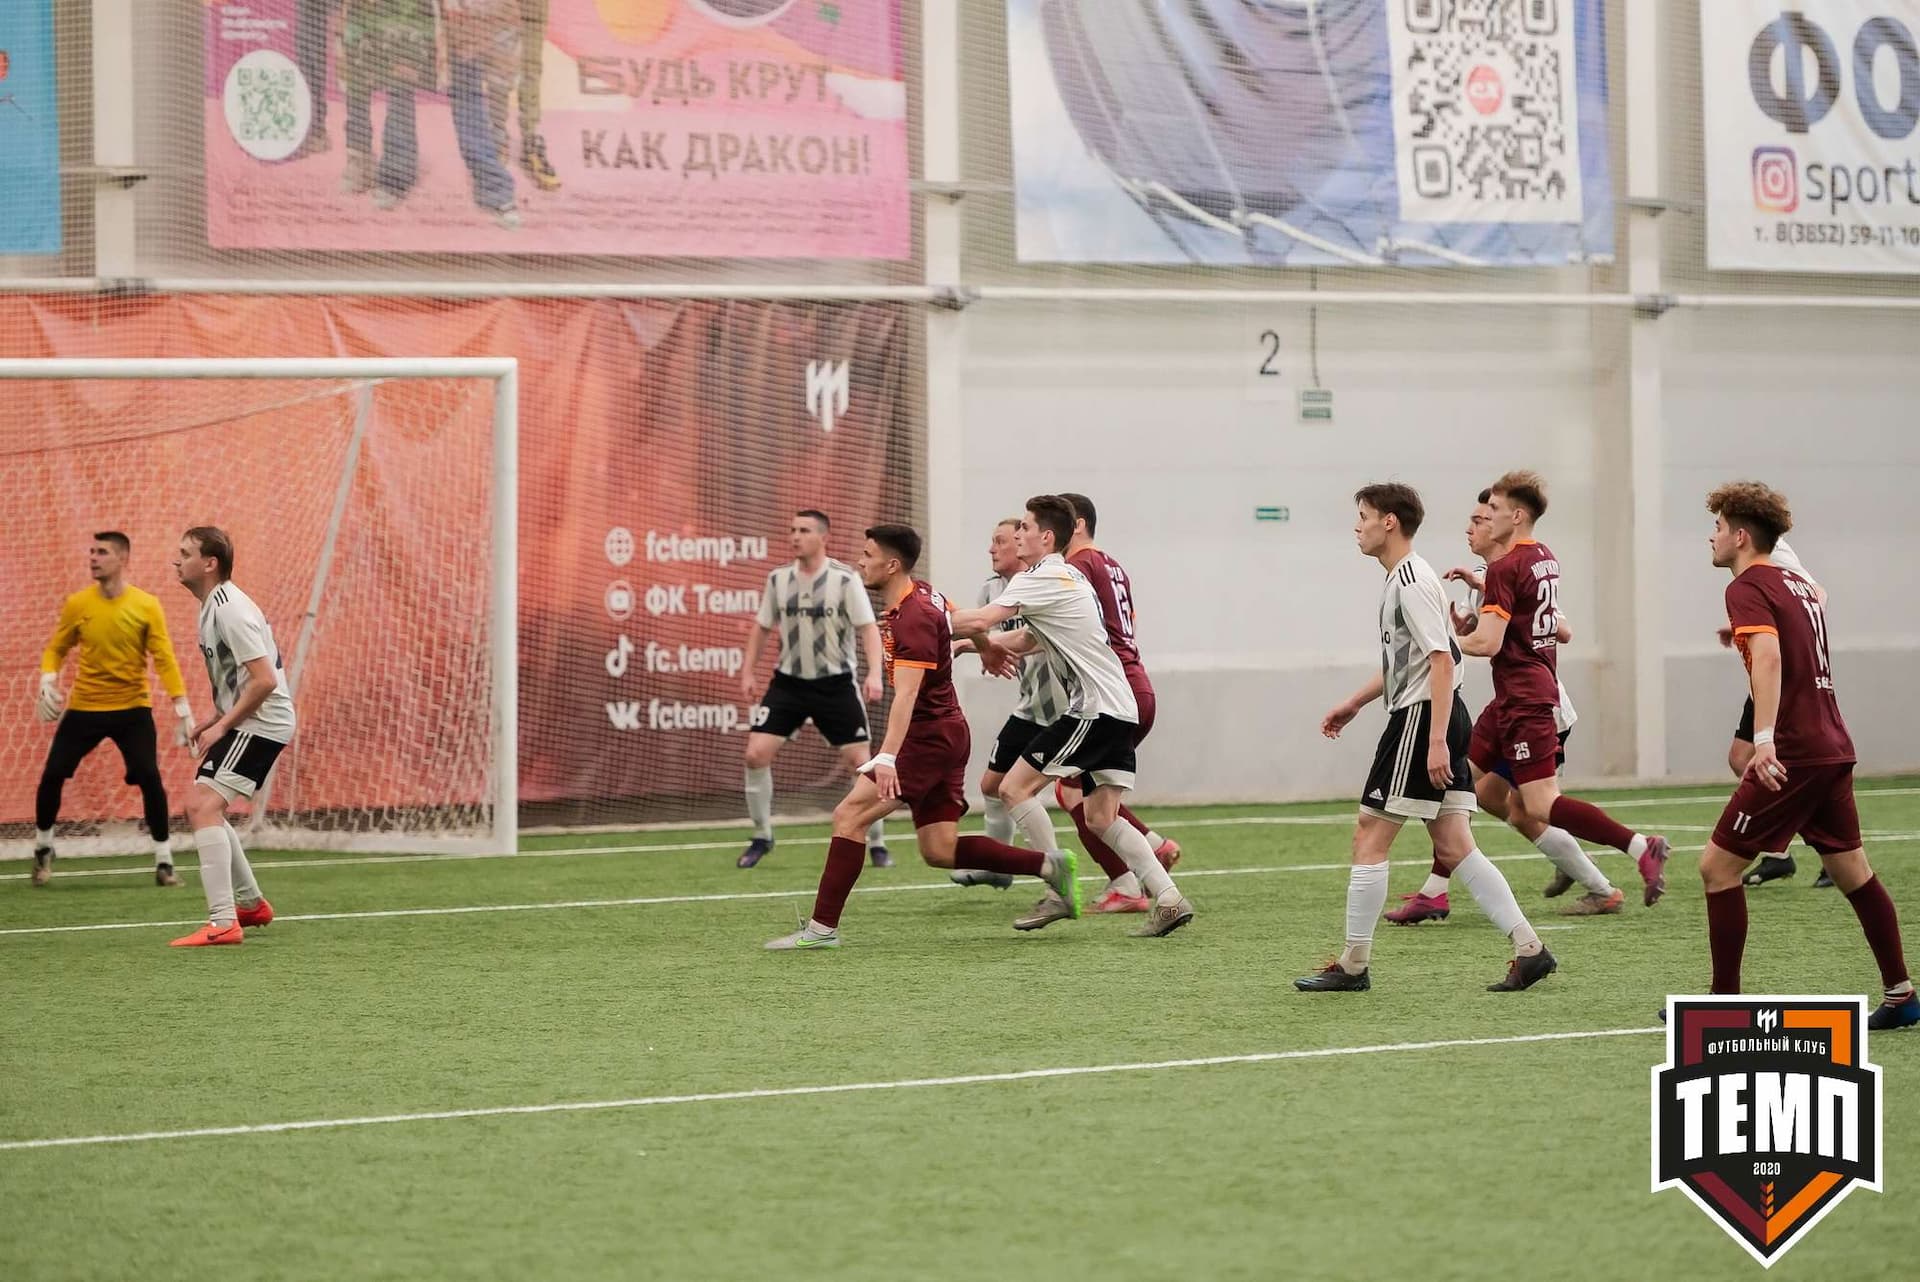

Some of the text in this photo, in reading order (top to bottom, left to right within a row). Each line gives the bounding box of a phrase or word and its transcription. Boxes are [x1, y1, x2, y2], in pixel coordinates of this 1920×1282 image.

[577, 55, 716, 105] БУДЬ
[581, 129, 871, 180] КАК ДРАКОН!
[1260, 329, 1280, 376] 2
[645, 530, 769, 568] fctemp.ru
[645, 583, 761, 616] ФК Темп
[645, 641, 743, 679] fc.temp
[1513, 741, 1531, 761] 25
[1732, 811, 1752, 834] 11
